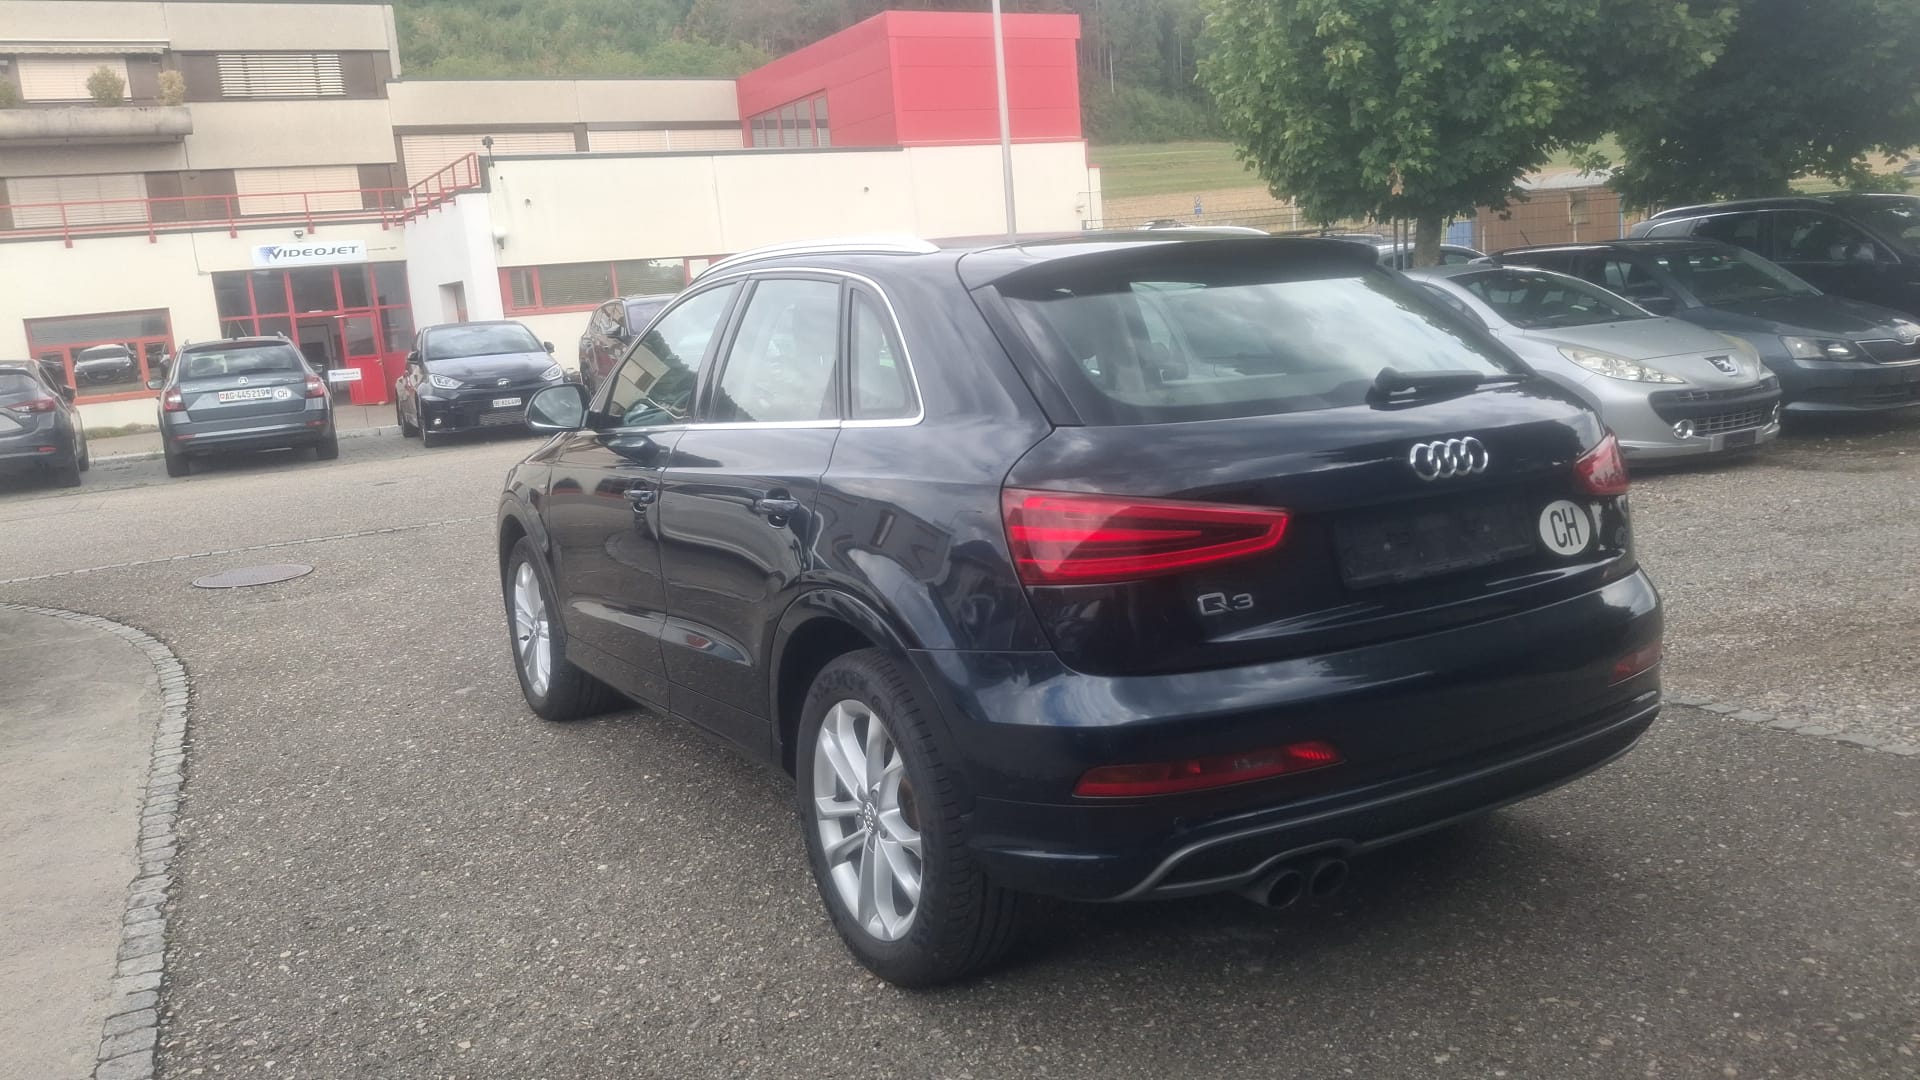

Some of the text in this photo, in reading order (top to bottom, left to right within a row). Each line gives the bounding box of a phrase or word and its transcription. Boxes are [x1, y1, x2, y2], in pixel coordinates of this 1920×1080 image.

[269, 245, 359, 260] VIDEOJET
[277, 390, 288, 398] CH
[1550, 507, 1582, 548] CH
[1197, 592, 1254, 616] Q3
